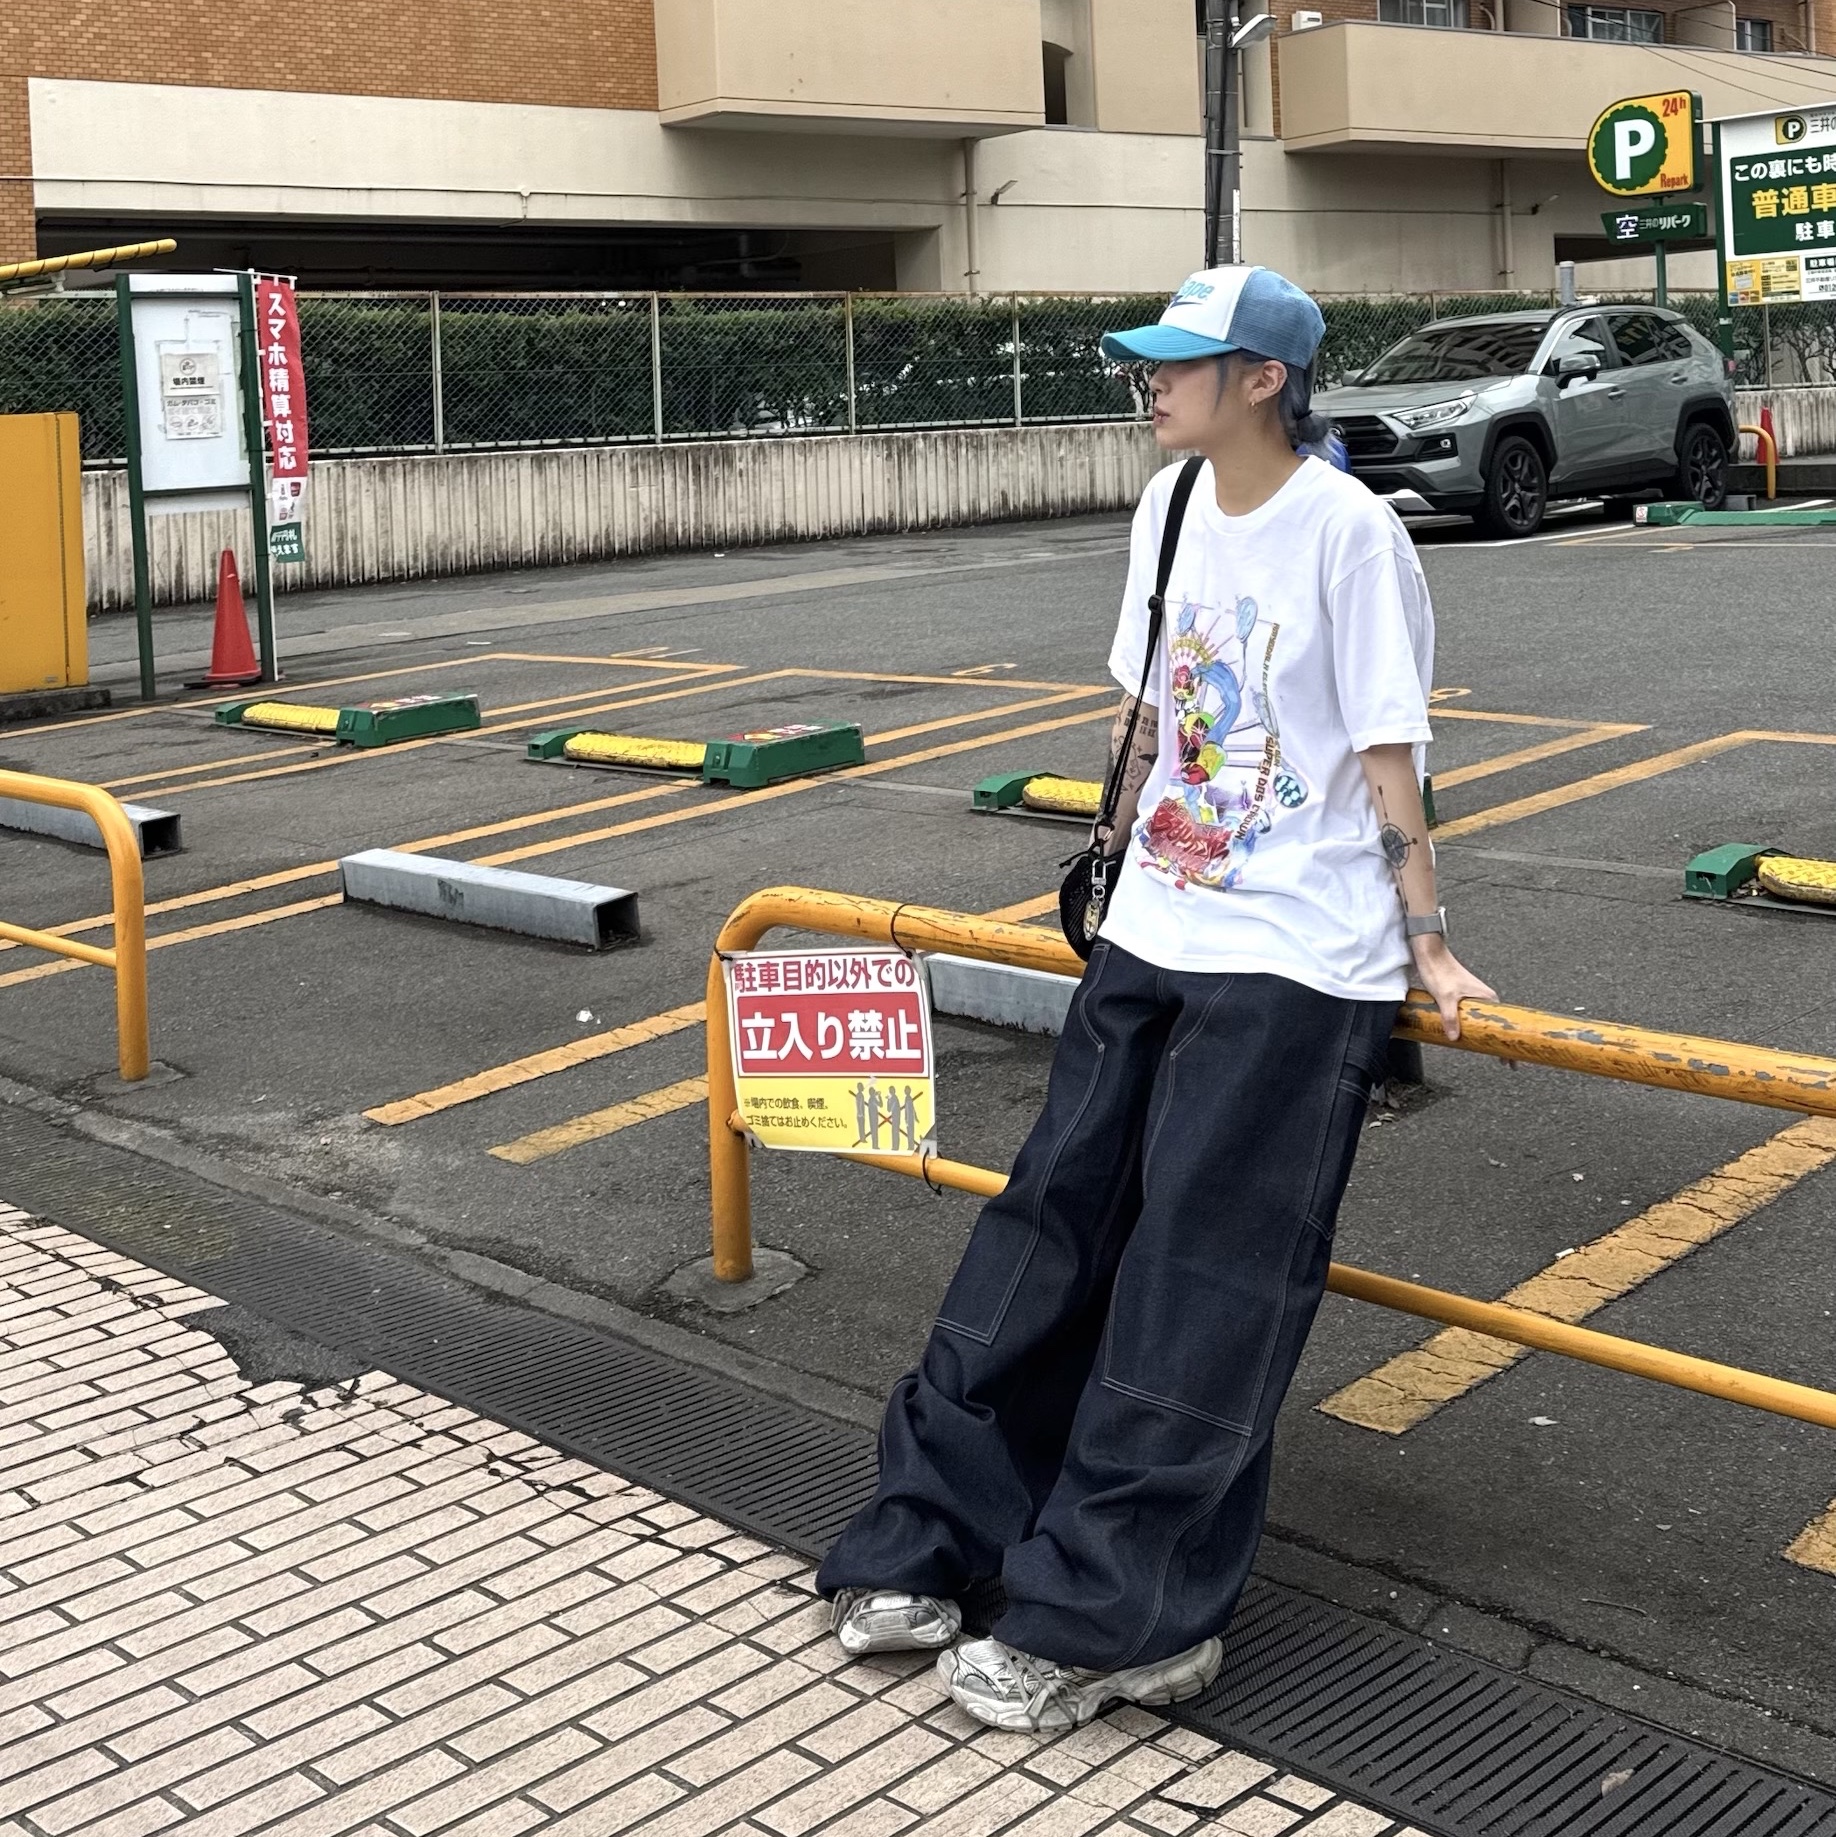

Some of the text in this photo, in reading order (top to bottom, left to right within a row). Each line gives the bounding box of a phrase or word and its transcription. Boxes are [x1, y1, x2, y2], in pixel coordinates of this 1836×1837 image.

[1662, 97, 1687, 118] 24h
[1787, 121, 1801, 139] P
[1613, 118, 1656, 181] P
[1660, 172, 1689, 189] Repark
[1751, 182, 1836, 219] 普通車
[1615, 214, 1640, 240] 空
[1795, 219, 1836, 242] 駐車
[267, 292, 298, 470] スマホ精算対応
[1259, 735, 1275, 778] SUPER
[734, 957, 916, 993] 駐車目的以外での
[741, 1008, 922, 1061] 立入り禁止
[746, 1114, 848, 1129] ゴミ捨てはお止めください。
